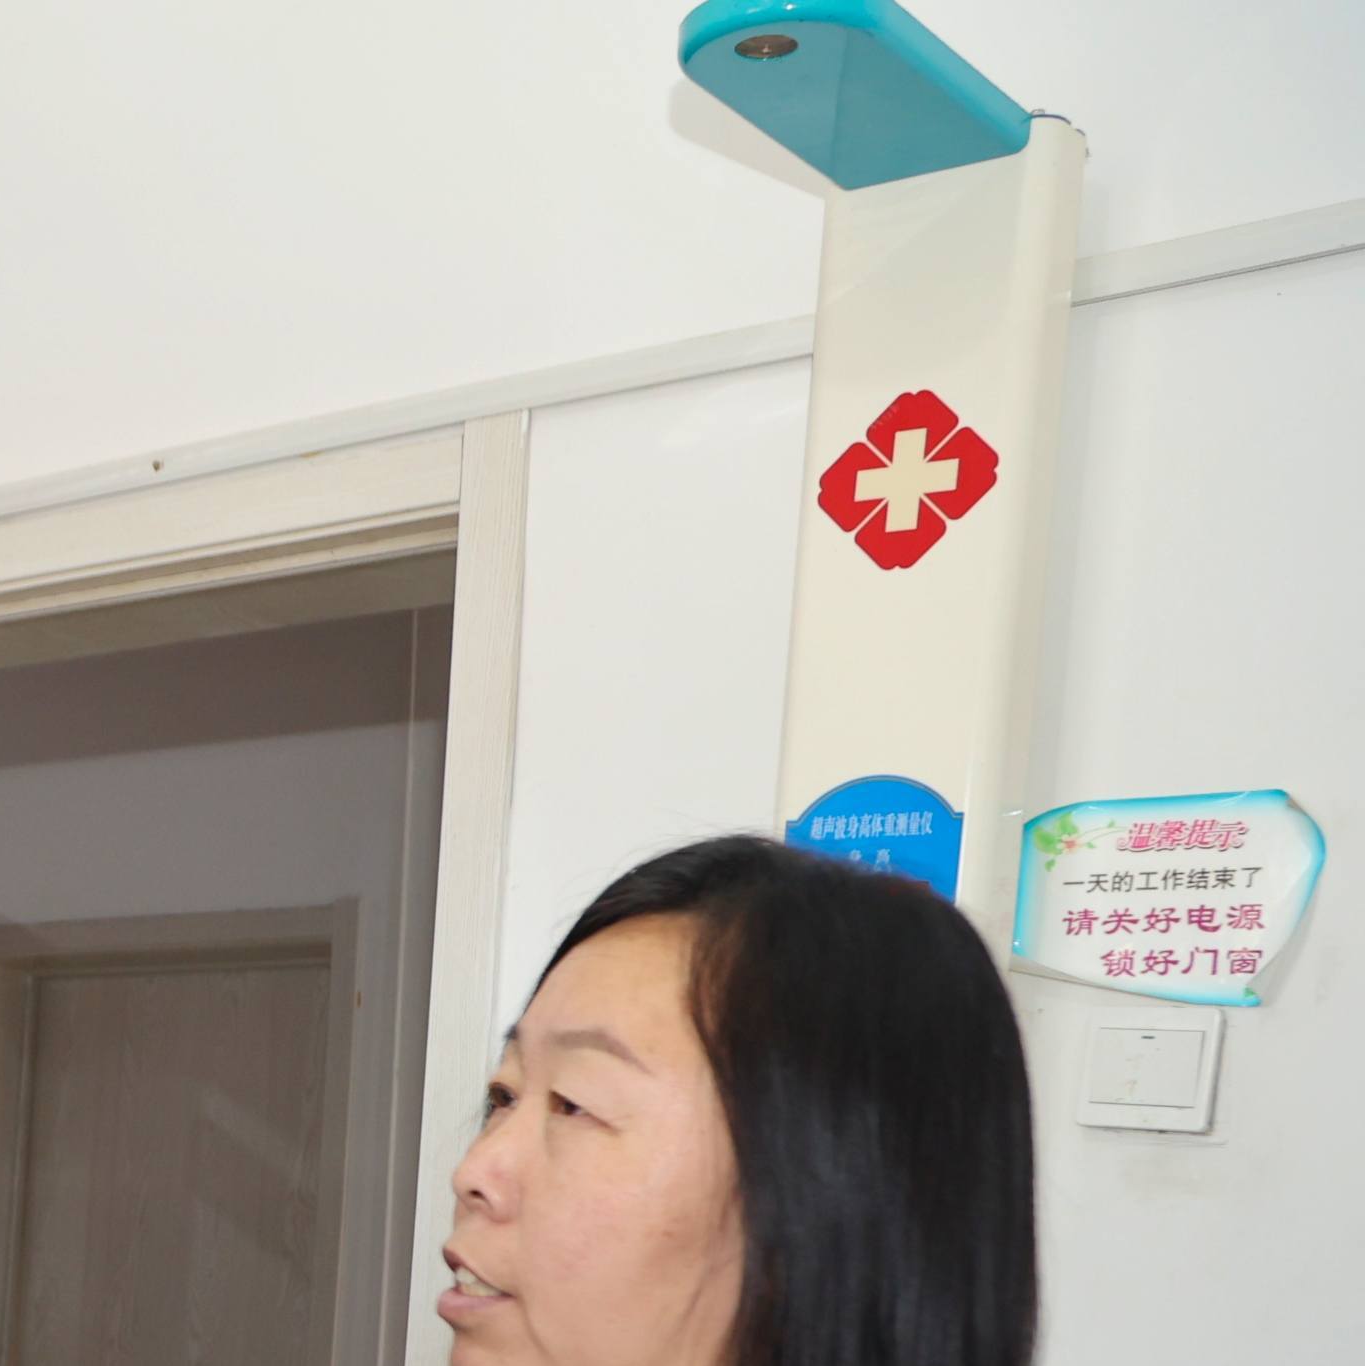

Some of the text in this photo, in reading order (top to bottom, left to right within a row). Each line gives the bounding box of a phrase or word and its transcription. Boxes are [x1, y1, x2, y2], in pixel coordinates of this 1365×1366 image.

[810, 811, 933, 840] 超声波身高体重测量仪
[1119, 819, 1249, 852] 温馨提示
[1063, 867, 1263, 893] 一天的工作结束了
[1062, 904, 1265, 935] 请关好电源
[1101, 947, 1263, 976] 锁好门窗
